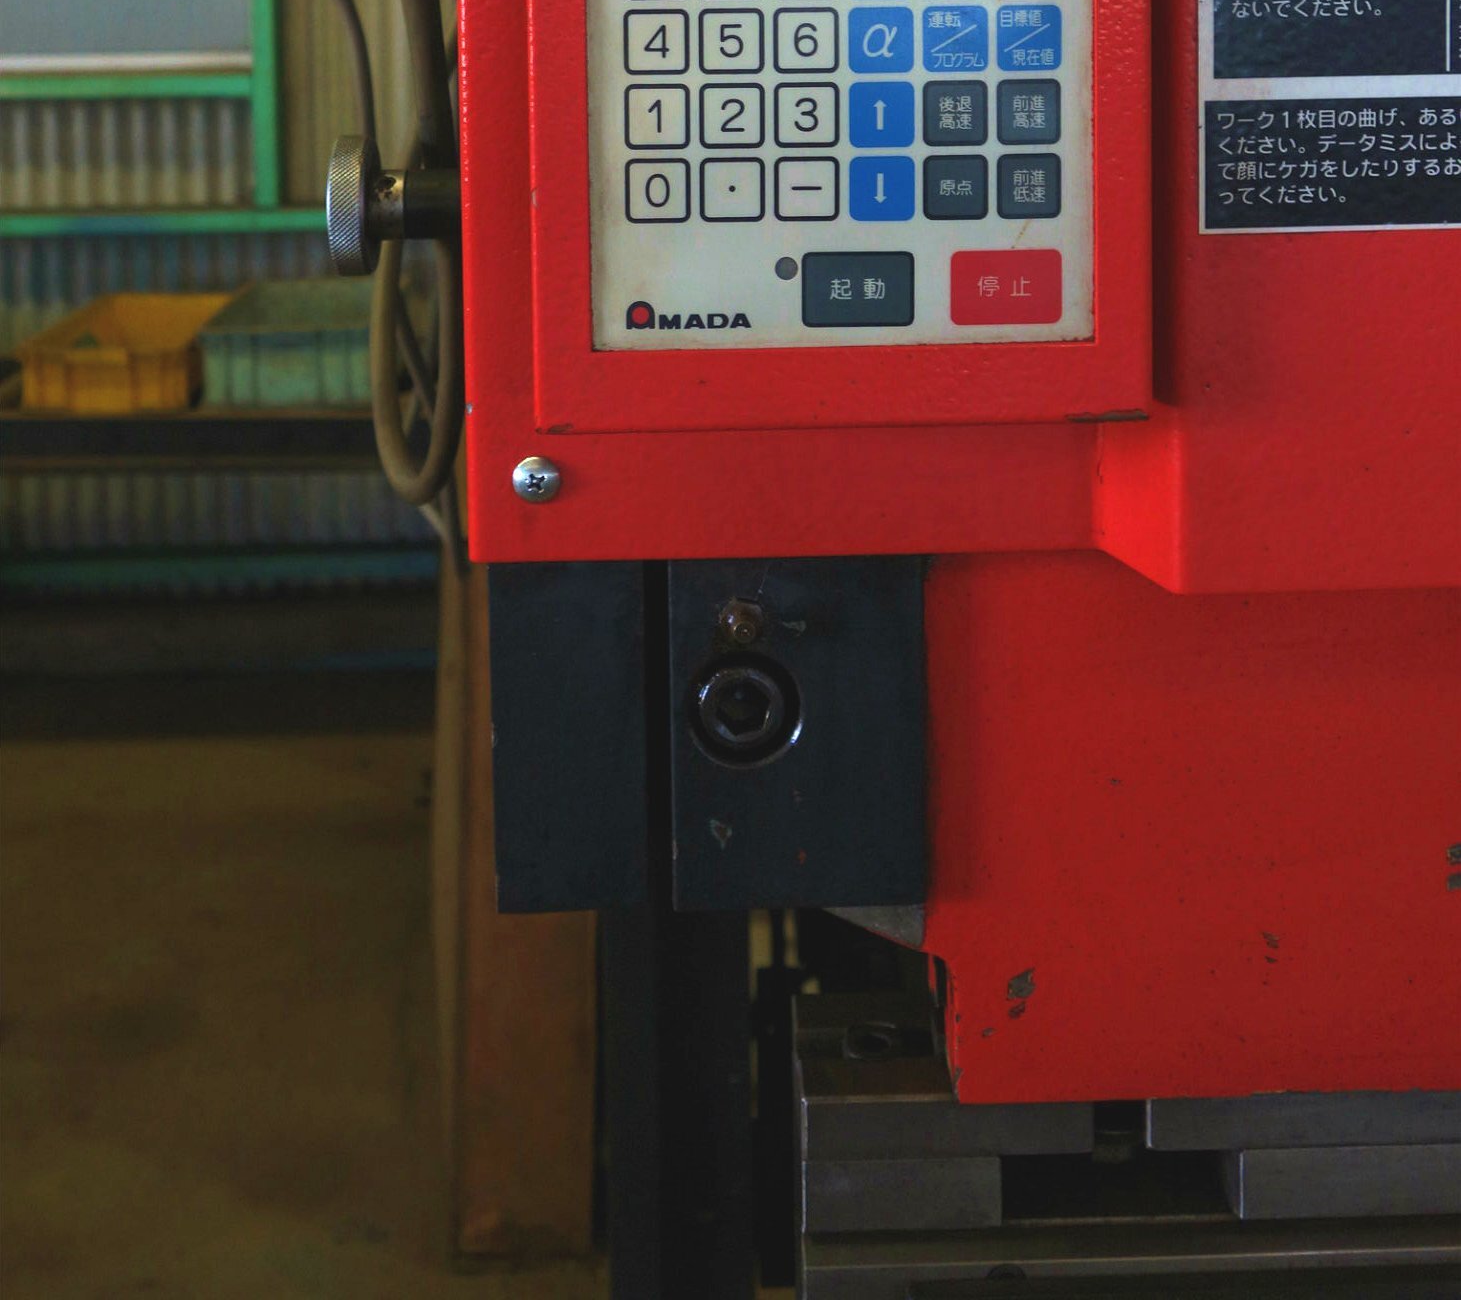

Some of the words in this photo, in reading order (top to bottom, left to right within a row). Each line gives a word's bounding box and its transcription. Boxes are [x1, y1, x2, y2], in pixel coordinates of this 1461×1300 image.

[1231, 0, 1382, 18] ないでください。
[928, 11, 961, 28] 運転
[1000, 10, 1042, 28] 目標値
[644, 24, 670, 59] 4
[719, 23, 744, 58] 5
[793, 22, 818, 57] 6
[931, 52, 984, 68] プログラム
[1012, 48, 1054, 66] 現在値
[939, 95, 973, 113] 後退
[1013, 95, 1046, 112] 前進
[647, 99, 662, 133] 1
[720, 98, 745, 133] 2
[794, 97, 819, 132] 3
[939, 113, 973, 130] 高速
[1013, 112, 1046, 129] 高速
[1217, 108, 1461, 130] ワーク1枚目の曲げ、ある
[1218, 133, 1461, 156] ください。データミスによ
[1013, 169, 1046, 186] 前進
[645, 173, 670, 208] 0
[939, 179, 973, 196] 原点
[1013, 186, 1046, 203] 低速
[1218, 185, 1347, 205] ってください。
[626, 300, 752, 330] AMADA
